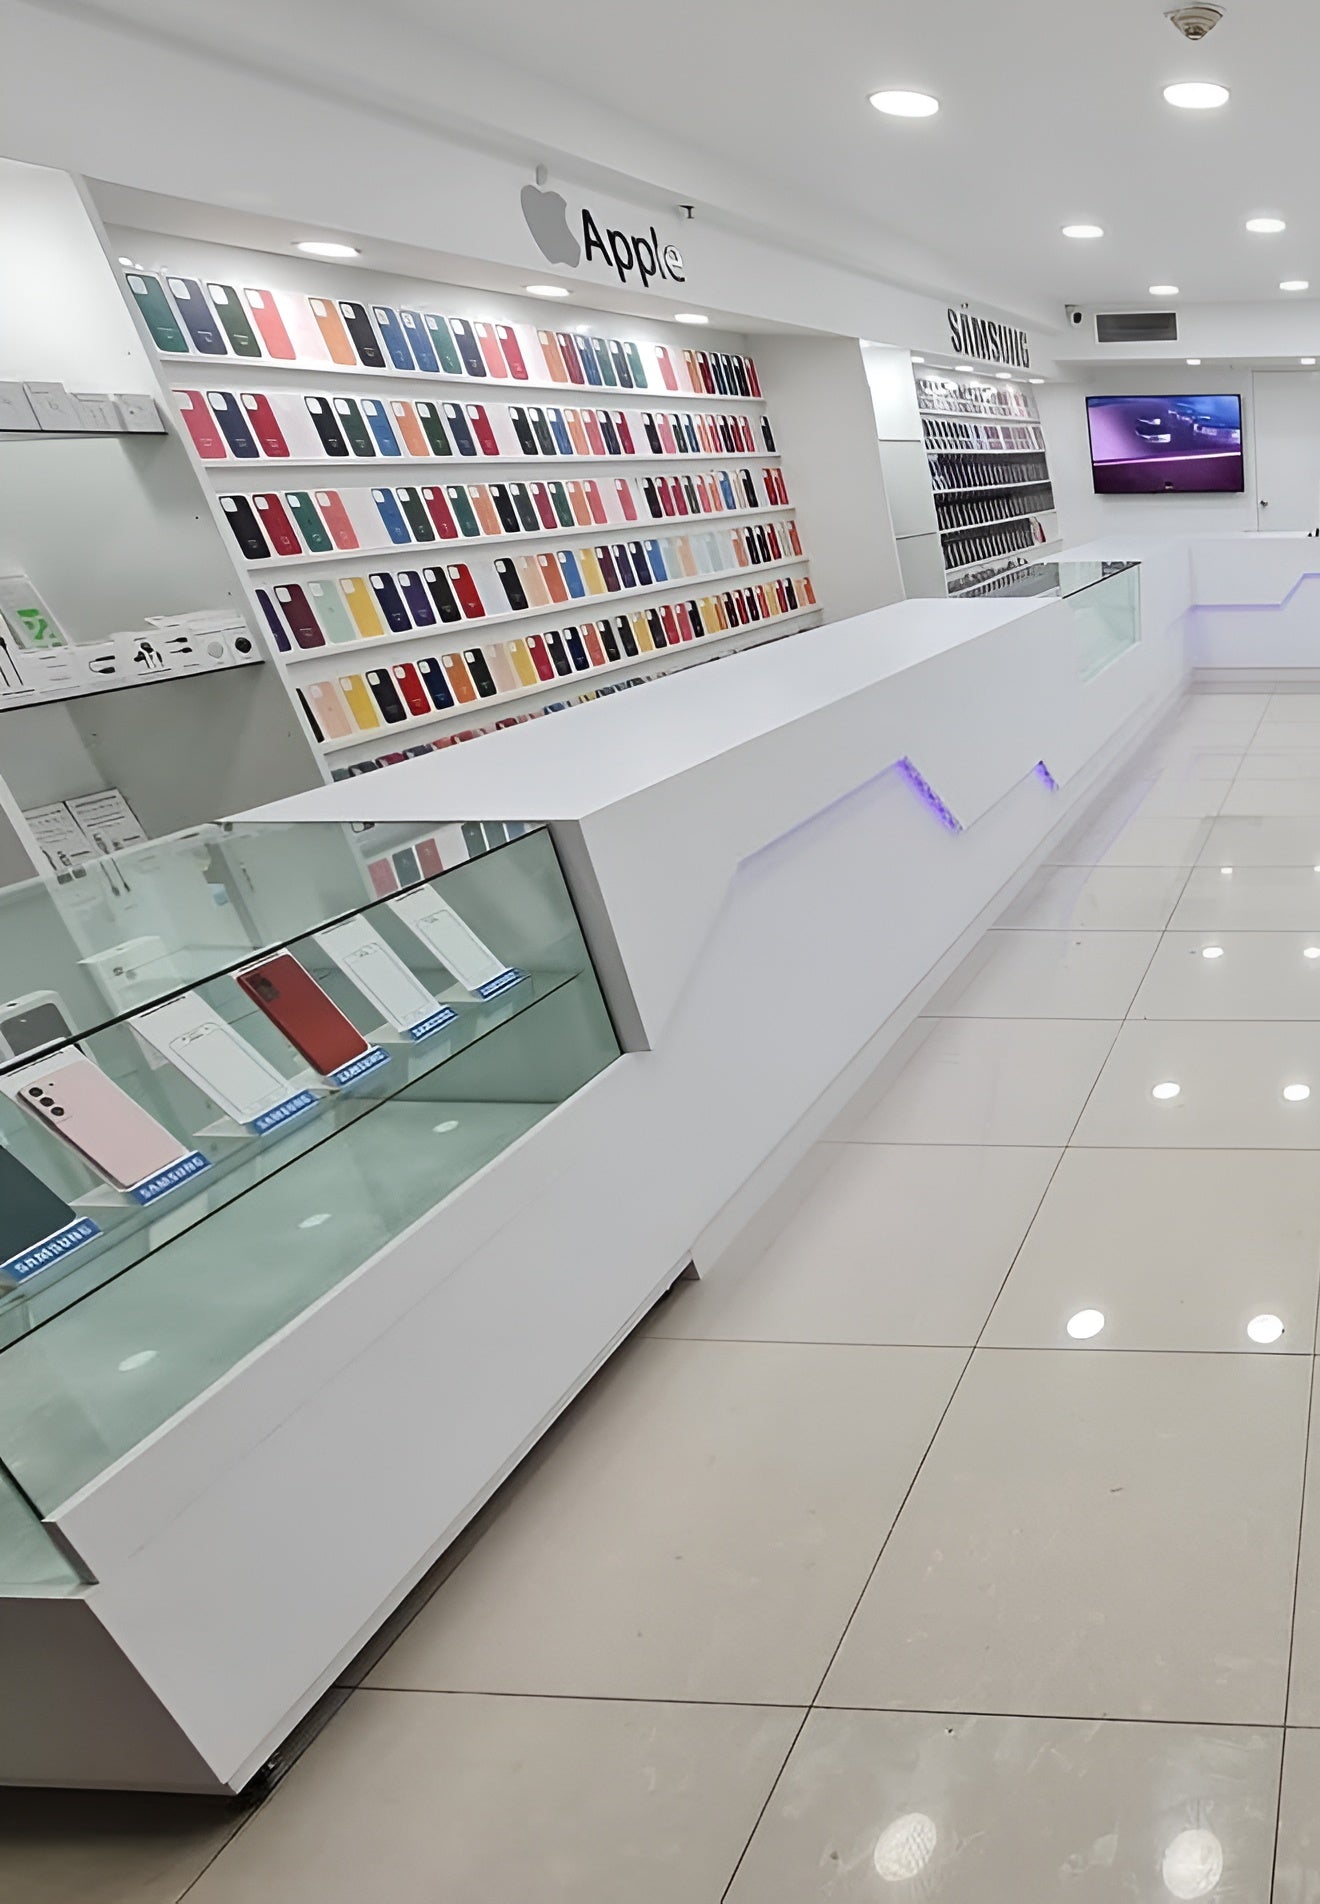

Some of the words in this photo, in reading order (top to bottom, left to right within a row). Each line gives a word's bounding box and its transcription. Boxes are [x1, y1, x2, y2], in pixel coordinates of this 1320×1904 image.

[582, 208, 686, 288] Apple
[948, 307, 1030, 368] SAMSUNG
[139, 1155, 204, 1200] SAMSUNG
